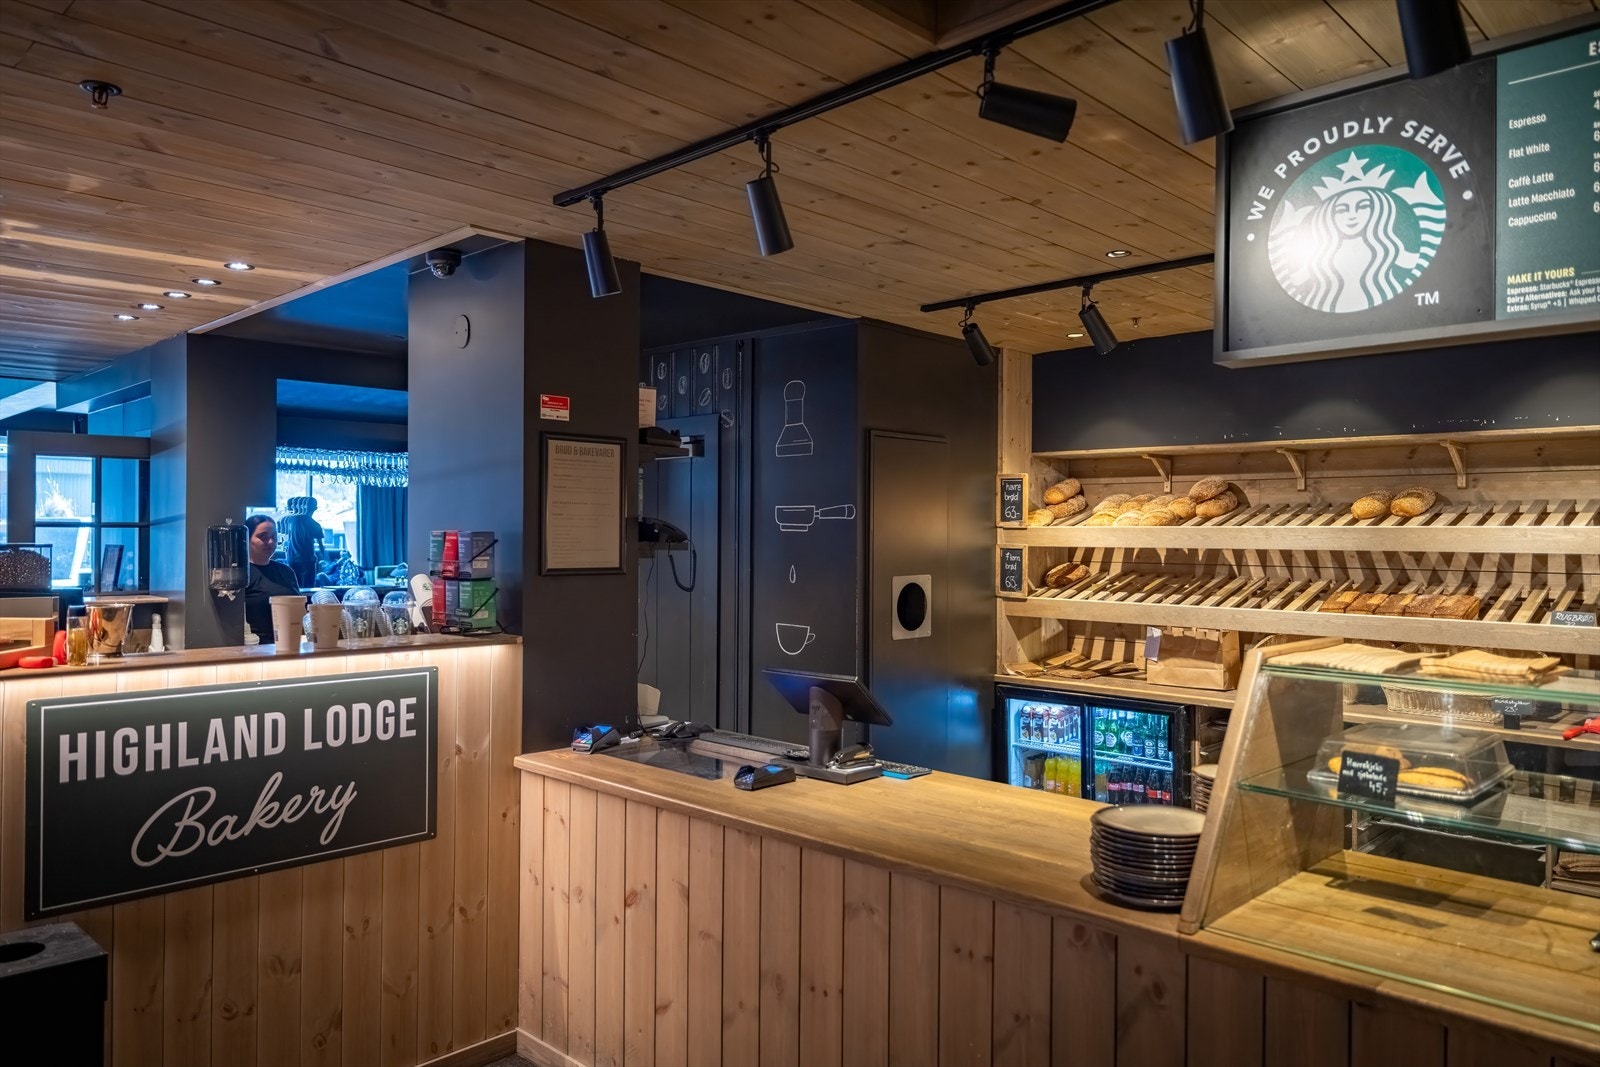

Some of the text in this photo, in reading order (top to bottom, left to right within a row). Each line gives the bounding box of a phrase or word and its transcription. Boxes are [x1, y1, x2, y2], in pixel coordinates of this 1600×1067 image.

[1508, 113, 1547, 129] Espresso
[1508, 142, 1551, 159] Flat White
[1246, 116, 1471, 222] WE PROUDLY SERVE
[1508, 172, 1554, 189] Caffè Latte
[1508, 188, 1576, 208] Latte Macchiato
[1508, 211, 1557, 227] Cappuccino
[1507, 266, 1575, 285] MAKE IT YOURS
[1414, 290, 1440, 306] TM
[1506, 285, 1539, 296] Espresso:
[1506, 295, 1525, 305] Dairy
[1525, 290, 1568, 302] Alternatives:
[1569, 288, 1581, 296] Ask
[1582, 286, 1596, 296] your
[1506, 303, 1530, 313] Extras:
[1568, 295, 1597, 305] Whipped
[579, 446, 615, 458] BAKEVARER
[59, 696, 418, 784] HIGHLAND LODGE
[130, 771, 358, 868] Bakery
